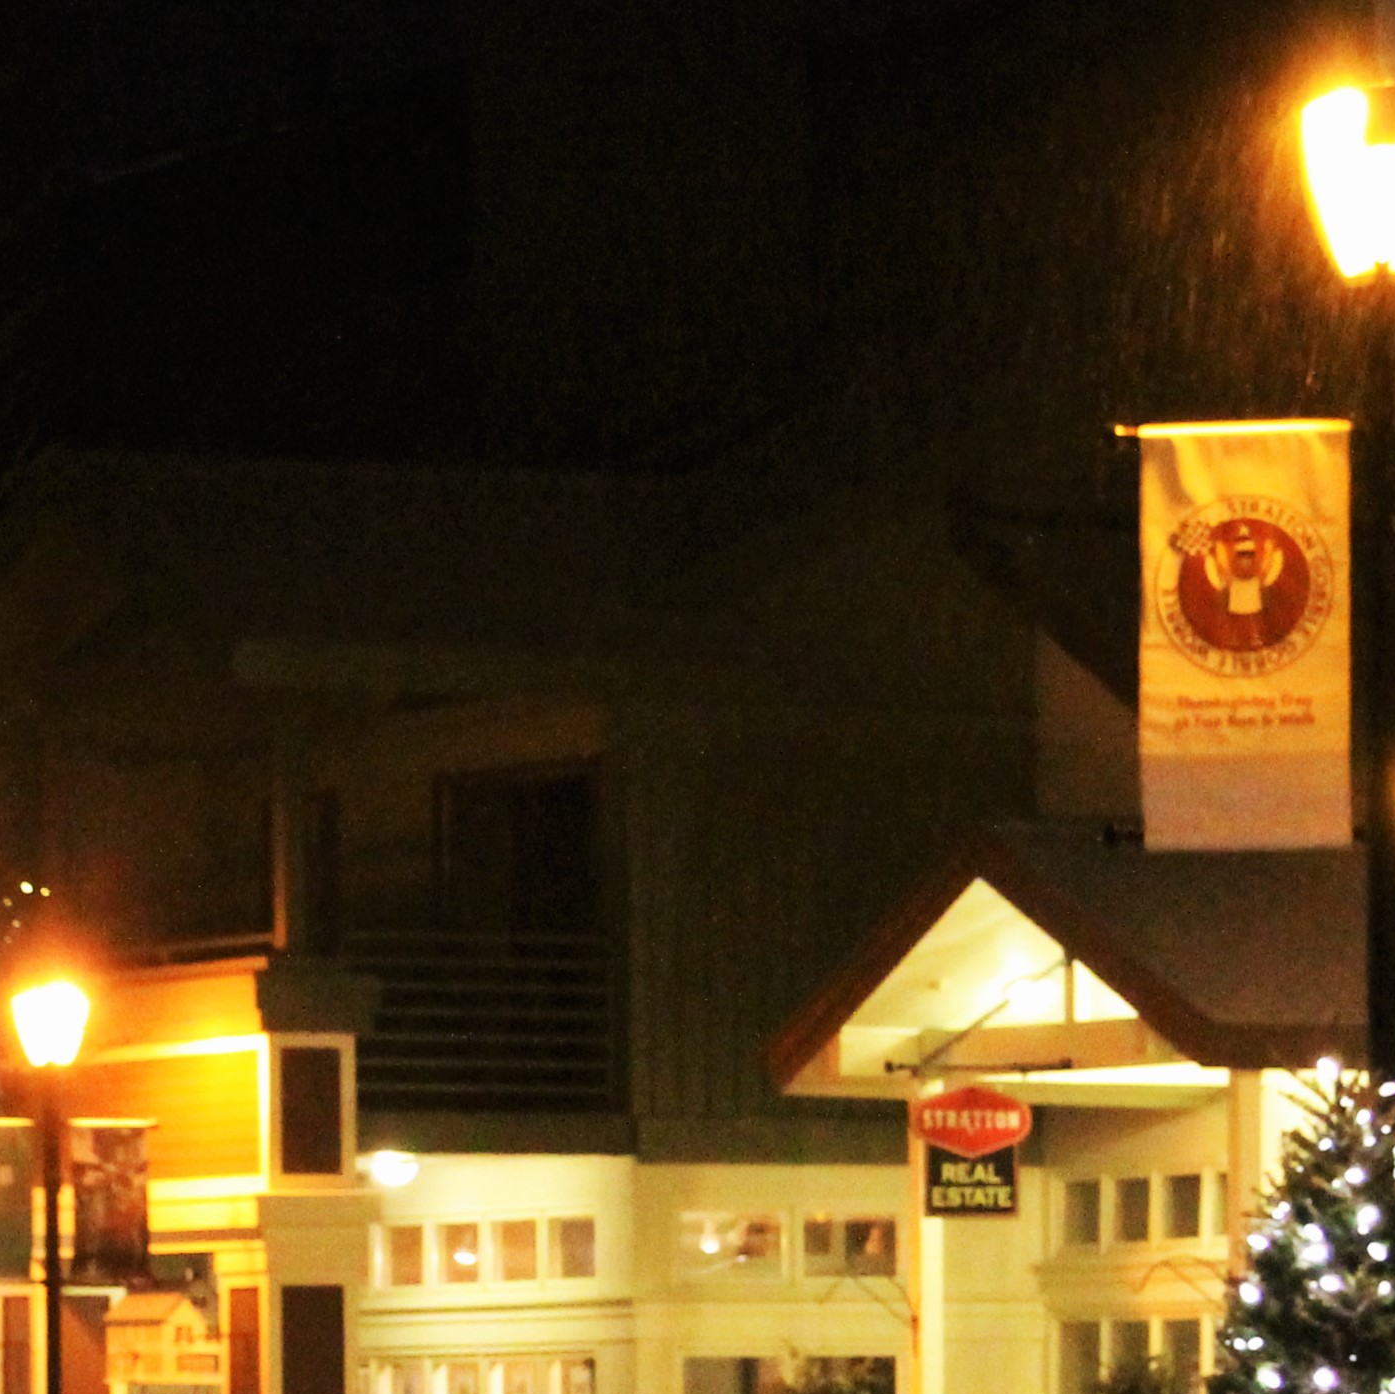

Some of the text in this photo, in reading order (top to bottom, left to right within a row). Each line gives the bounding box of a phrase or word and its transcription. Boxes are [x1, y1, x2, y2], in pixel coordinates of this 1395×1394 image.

[922, 1108, 1021, 1134] STRATTON
[940, 1161, 1002, 1185] REAL
[931, 1186, 1012, 1209] ESTATE
